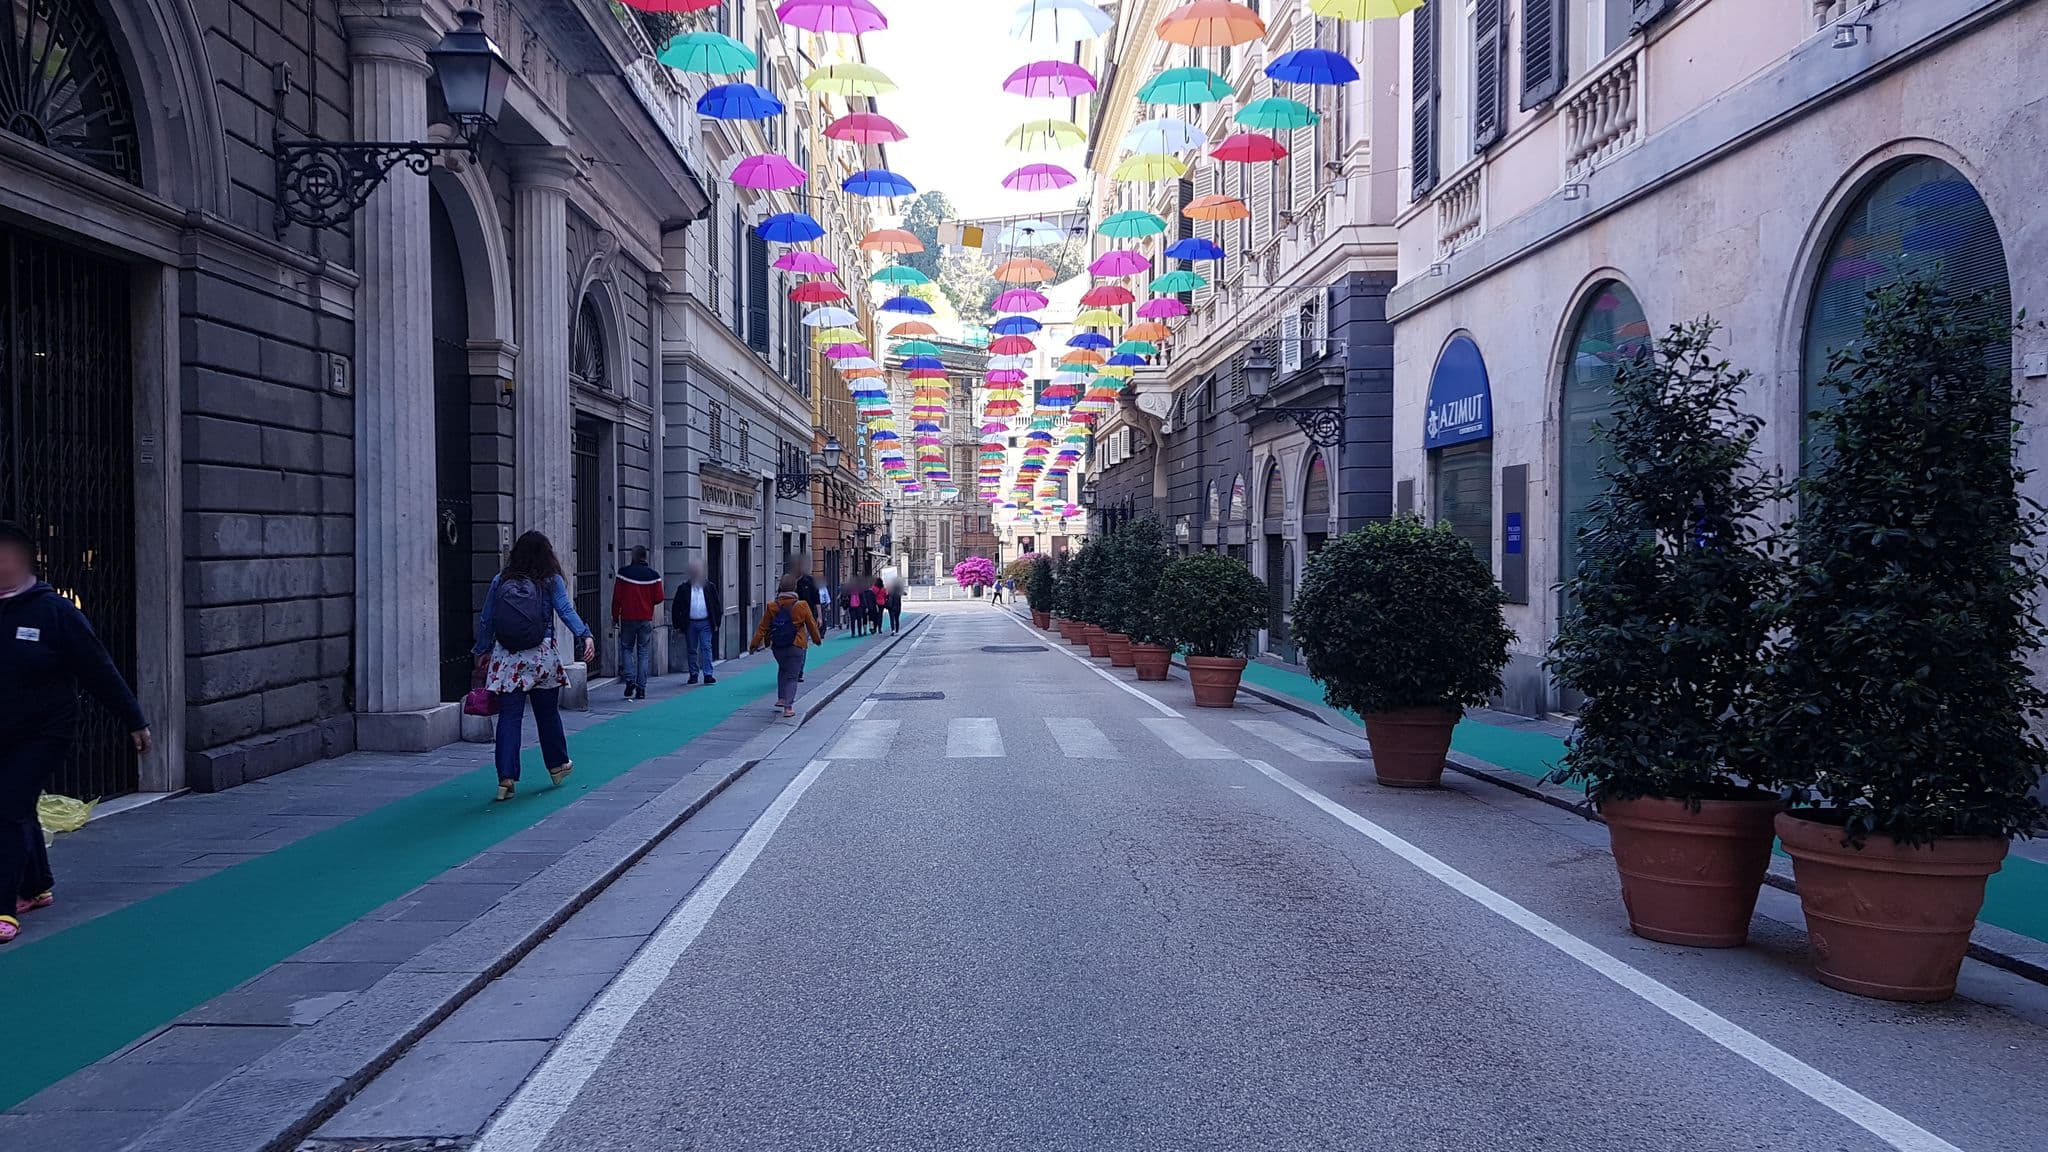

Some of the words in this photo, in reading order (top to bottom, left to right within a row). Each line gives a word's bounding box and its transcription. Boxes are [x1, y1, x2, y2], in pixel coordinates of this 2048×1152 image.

[1440, 394, 1484, 429] AZIMUT
[702, 484, 727, 505] DEVOTO
[734, 491, 754, 510] VITALE
